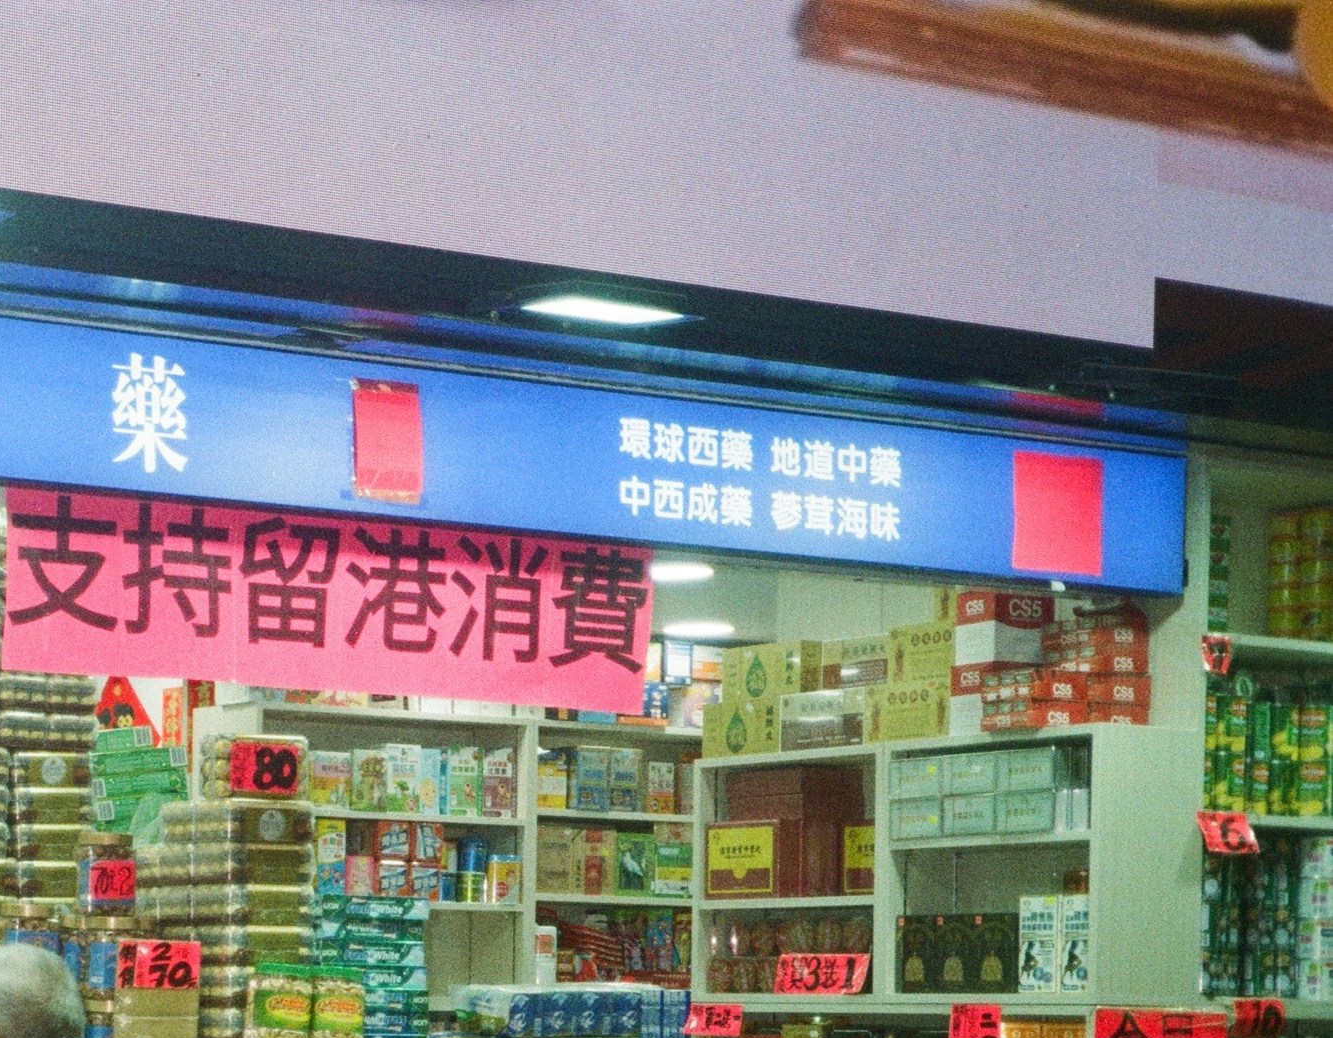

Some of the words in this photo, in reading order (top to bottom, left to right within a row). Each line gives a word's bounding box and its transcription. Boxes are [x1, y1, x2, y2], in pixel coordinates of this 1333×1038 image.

[619, 418, 753, 472] 環球西藥
[770, 436, 902, 489] 地道中藥
[619, 476, 753, 528] 中西成藥
[7, 496, 648, 673] 支持留港消費
[966, 600, 985, 615] CS5
[1009, 599, 1043, 618] CS5
[1114, 657, 1134, 671] CS5
[960, 672, 980, 687] CS5
[1053, 684, 1073, 698] CS5
[1114, 687, 1135, 701] CS5
[1048, 712, 1070, 726] CS5
[254, 747, 298, 790] 80
